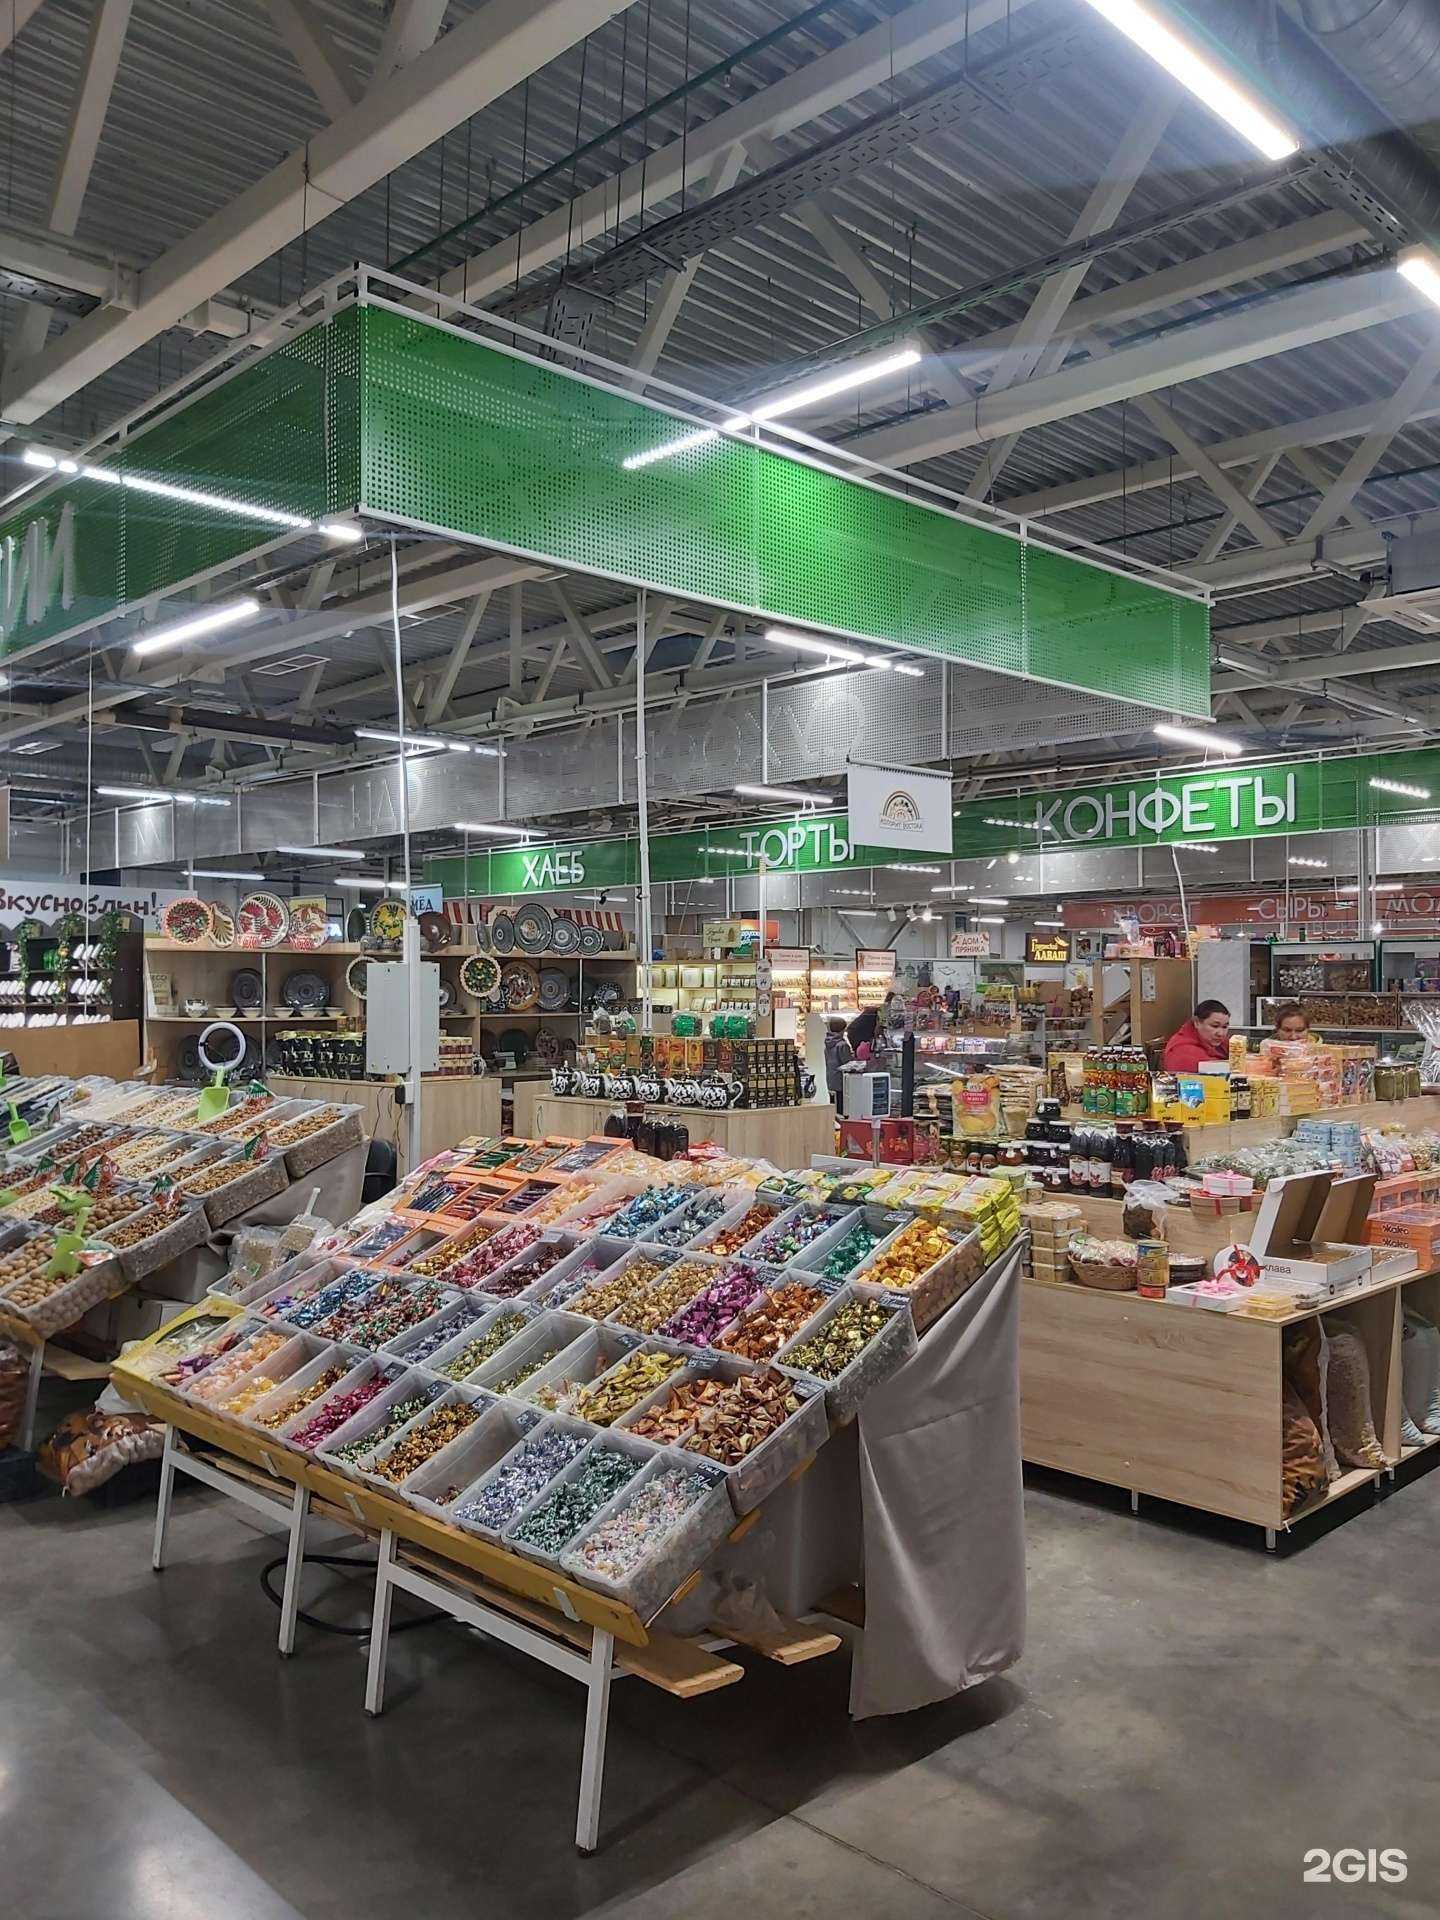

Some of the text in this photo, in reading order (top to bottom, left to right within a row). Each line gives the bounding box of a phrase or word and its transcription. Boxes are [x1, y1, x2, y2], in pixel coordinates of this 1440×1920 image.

[1035, 773, 1296, 844] КОНФЕТЫ
[739, 823, 855, 868] ТОРТЫ
[522, 850, 585, 888] ХЛЕБ
[1258, 897, 1326, 920] СЫРЫ
[955, 946, 986, 954] ПРЯНИКА
[962, 937, 979, 945] ДОМ
[1034, 951, 1067, 961] ЛАВАШ
